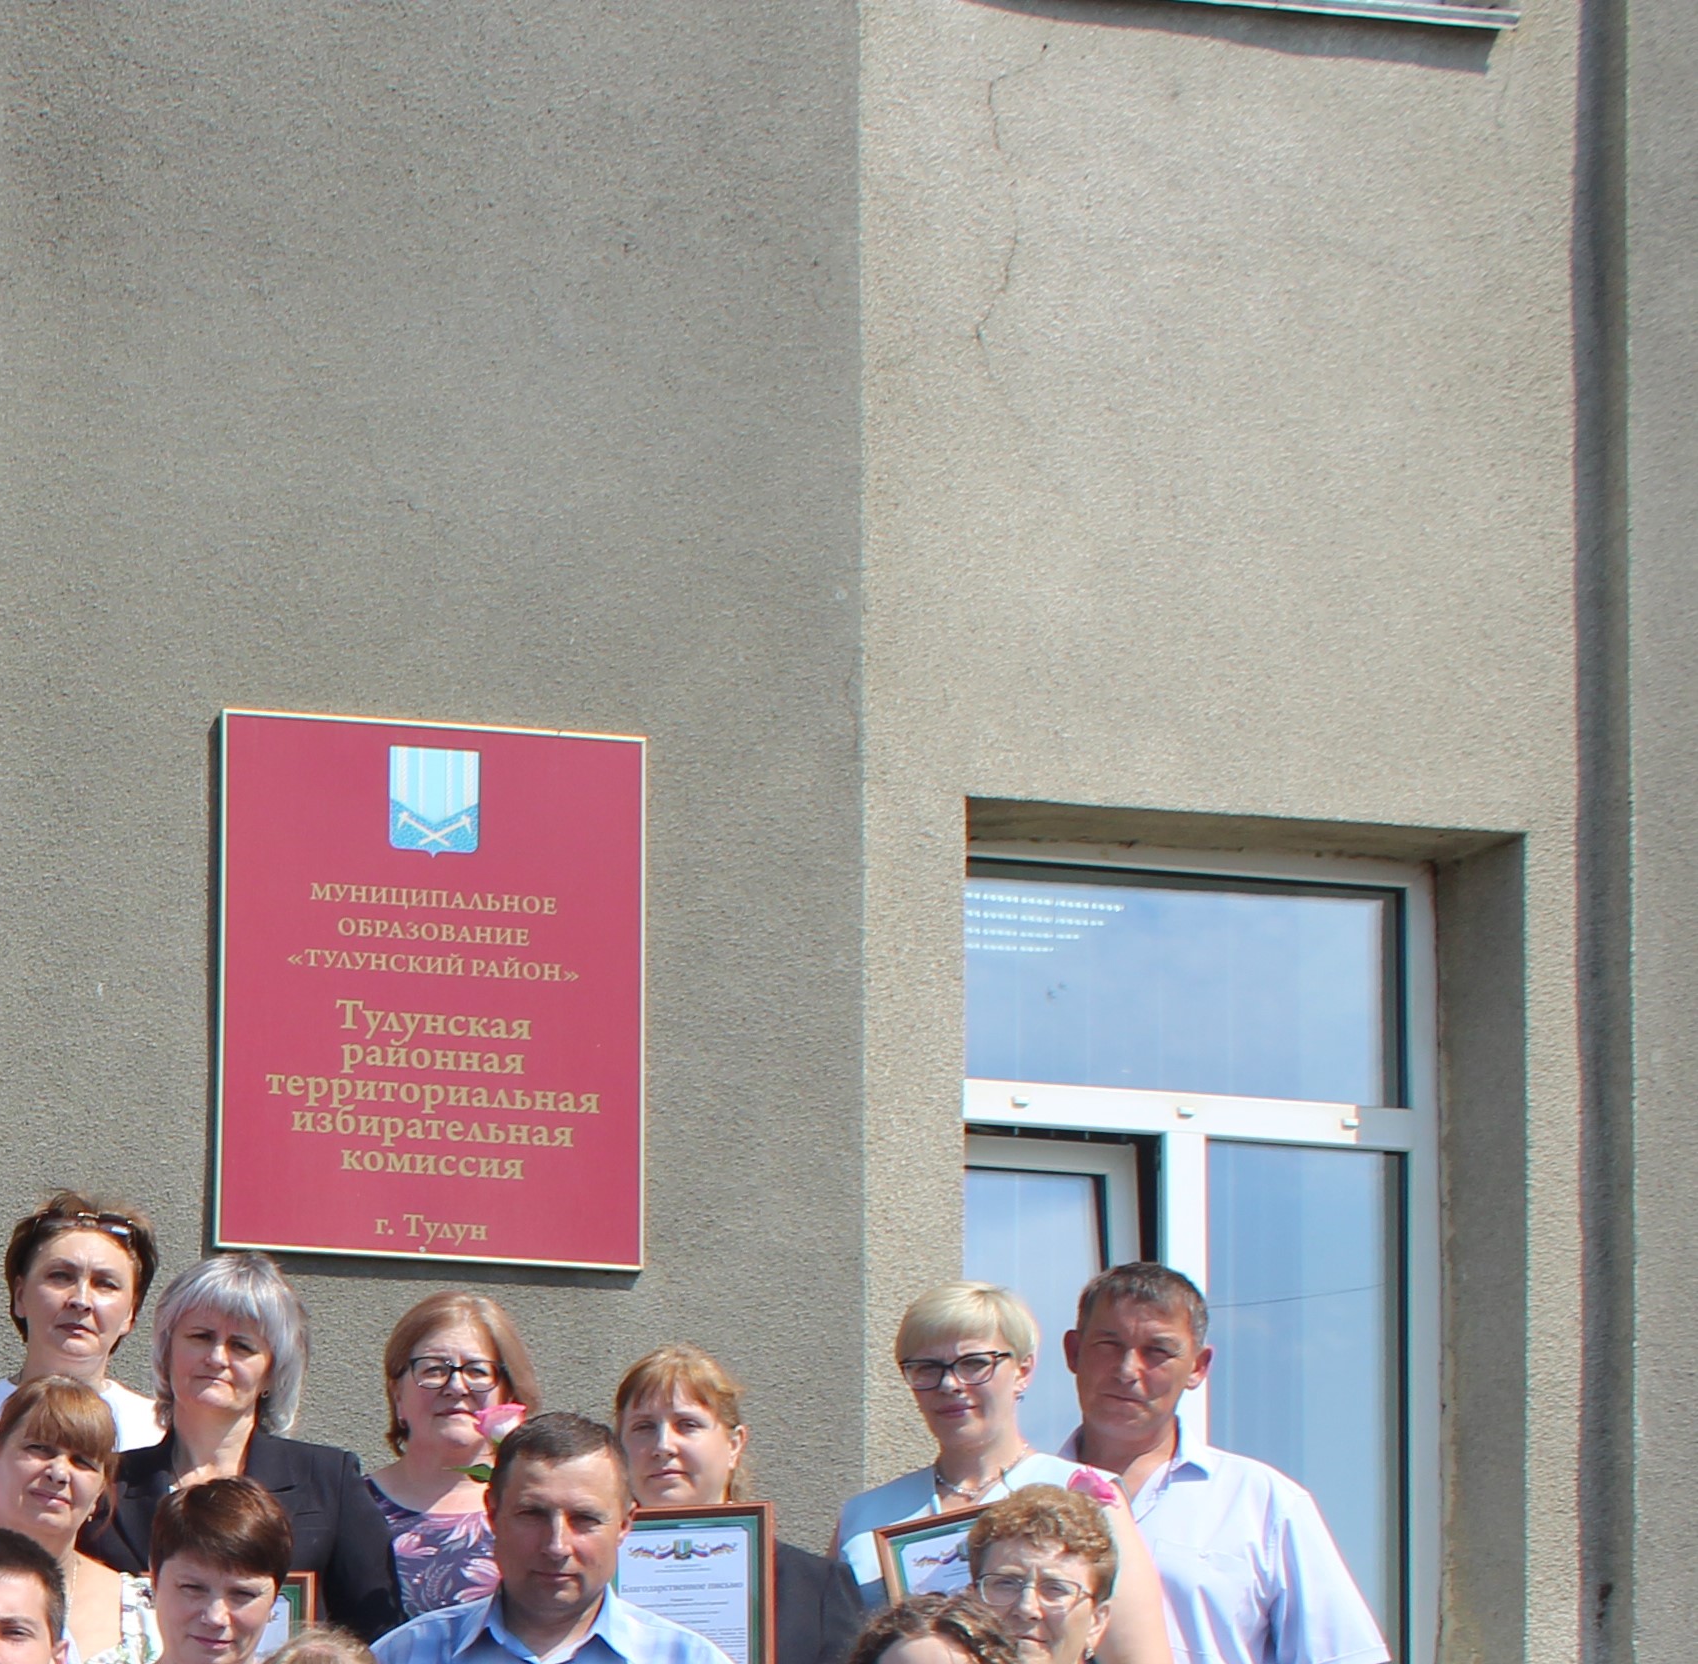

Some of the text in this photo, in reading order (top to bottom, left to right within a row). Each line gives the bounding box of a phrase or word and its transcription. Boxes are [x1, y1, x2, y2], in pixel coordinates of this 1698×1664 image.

[310, 882, 557, 915] МУНИЦИПАЛЬНОЕ
[338, 917, 530, 946] ОБРАЗОВАНИЕ
[287, 949, 579, 981] «ТУЛУНСКИЙ РАЙОН»
[335, 999, 532, 1046] Тулунская
[340, 1039, 525, 1074] районная
[265, 1074, 600, 1114] территориальная
[292, 1105, 574, 1148] избирательная
[341, 1149, 524, 1180] комиссия
[375, 1214, 487, 1246] г. Тулун
